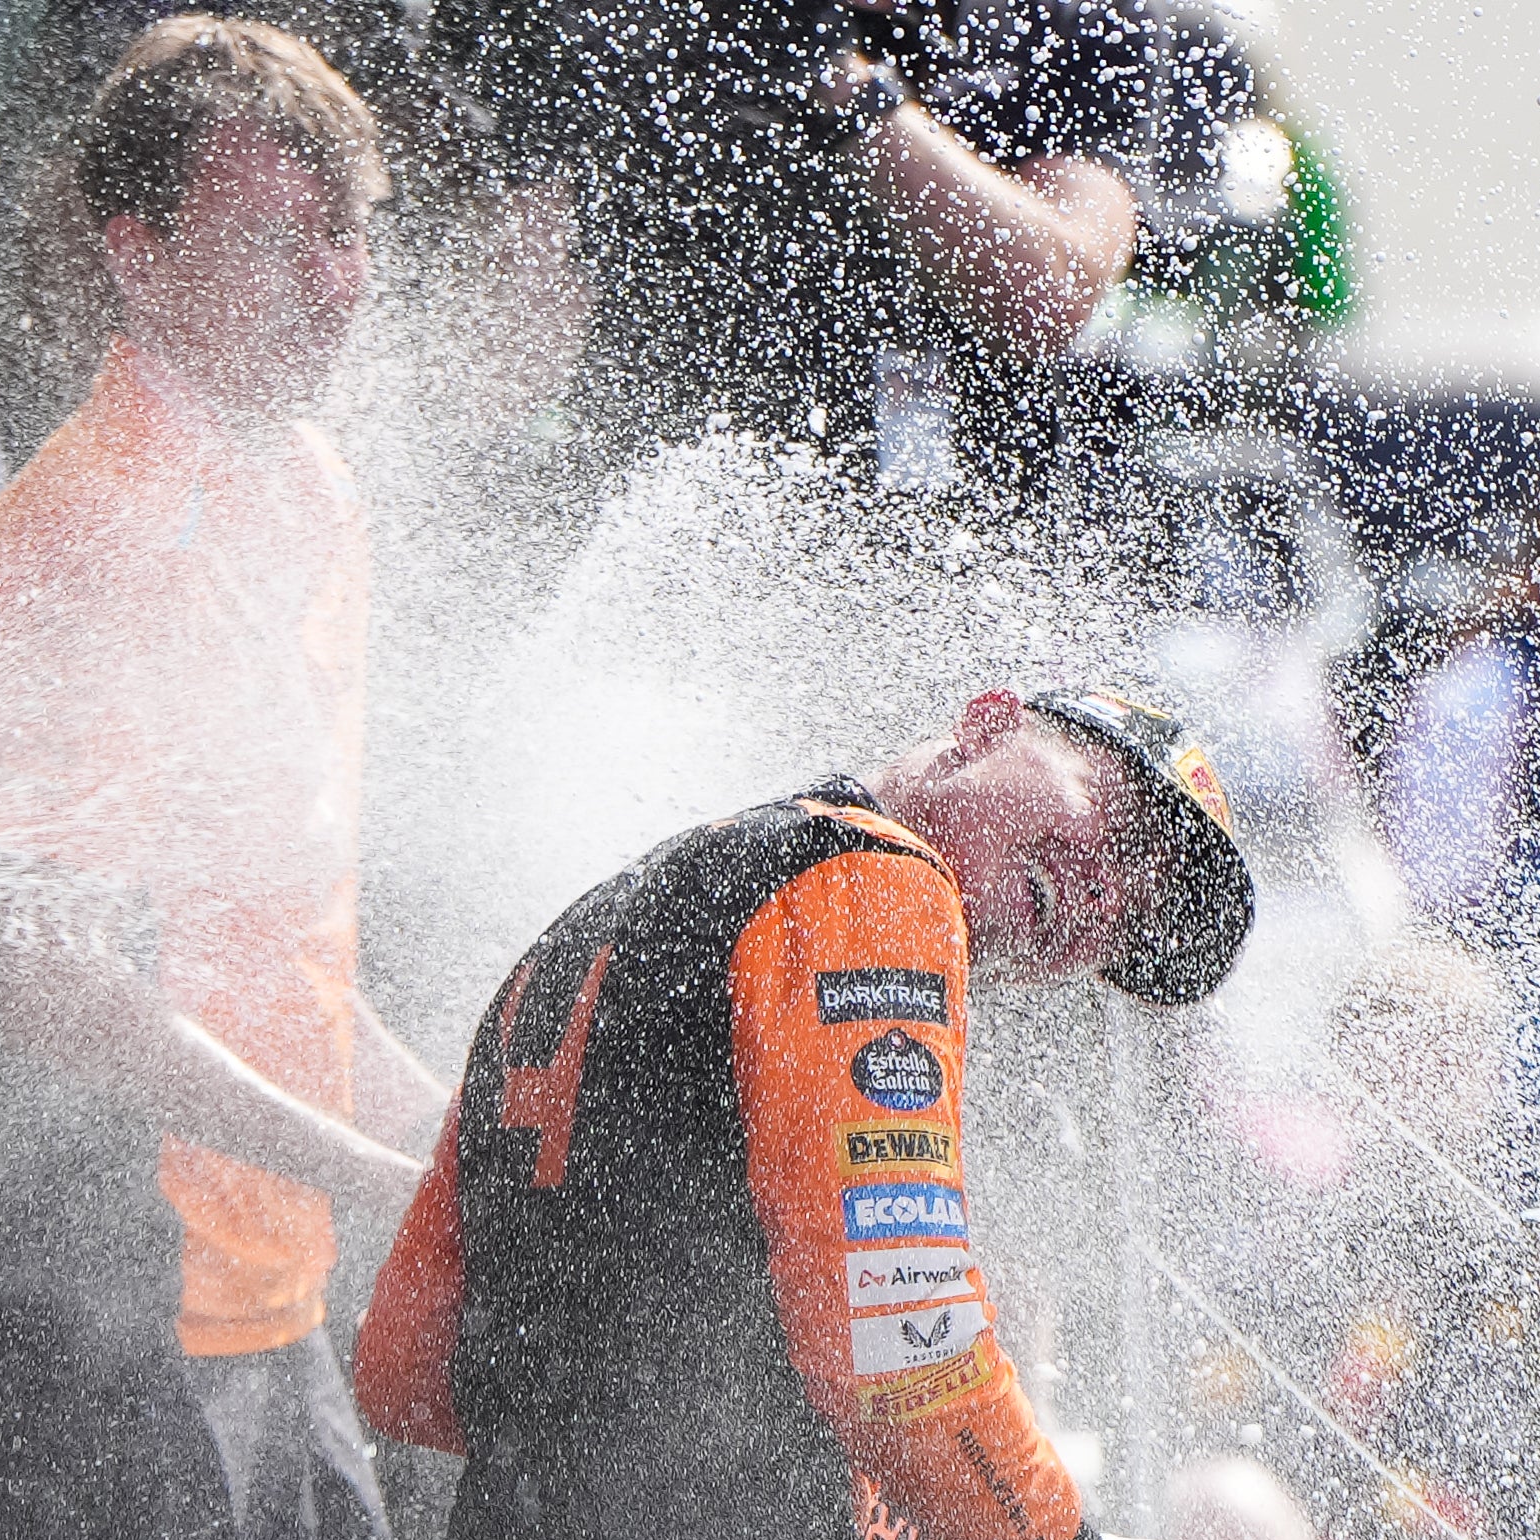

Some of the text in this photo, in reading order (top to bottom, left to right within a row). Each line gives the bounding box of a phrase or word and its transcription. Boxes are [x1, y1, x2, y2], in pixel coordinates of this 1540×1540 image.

[822, 982, 941, 1010] DARKTRACE
[498, 942, 614, 1188] 4
[854, 1195, 966, 1227] ECOLAB
